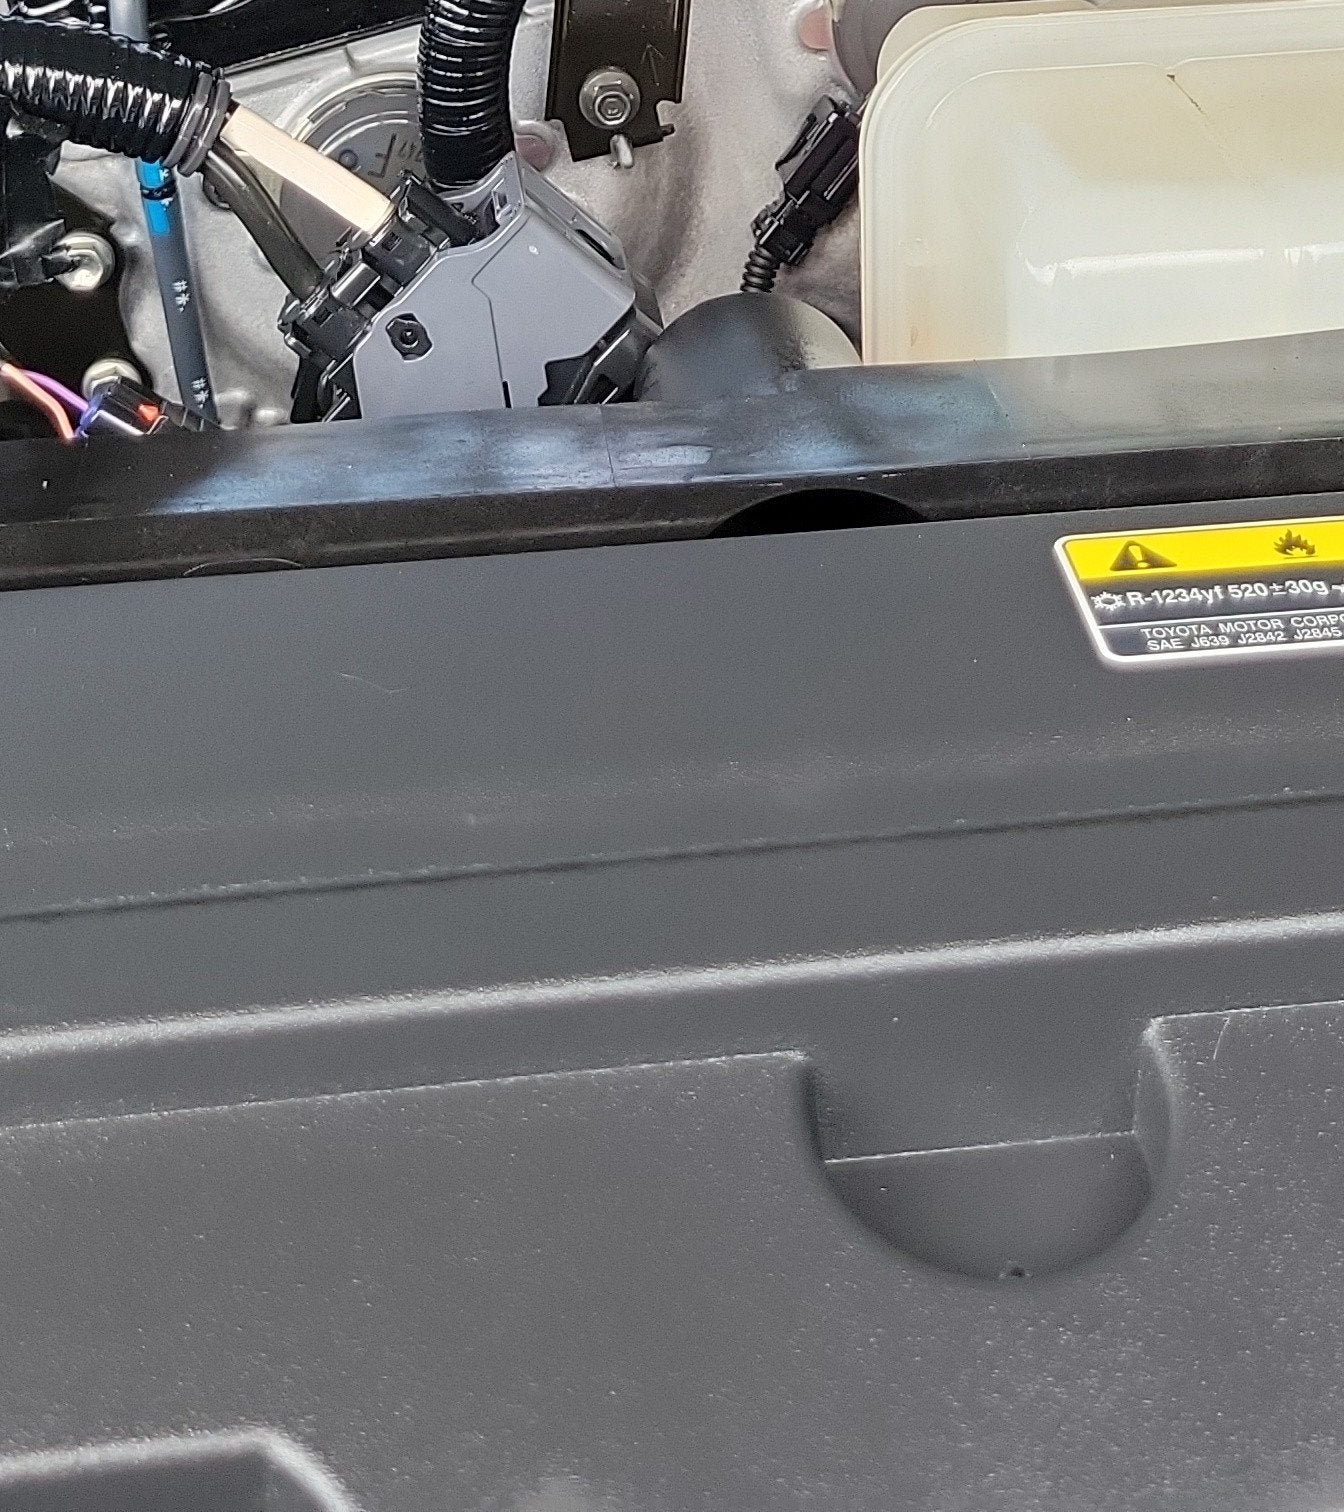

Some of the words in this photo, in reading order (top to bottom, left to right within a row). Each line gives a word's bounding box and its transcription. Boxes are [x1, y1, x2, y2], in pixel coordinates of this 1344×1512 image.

[1126, 584, 1224, 607] R-1234yf
[1140, 624, 1210, 639] TOYOTA
[1218, 618, 1285, 634] MOTOR
[1146, 638, 1184, 652] SAE
[1191, 634, 1230, 648] J639
[1237, 630, 1286, 644] J2842
[1293, 626, 1343, 640] J2845
